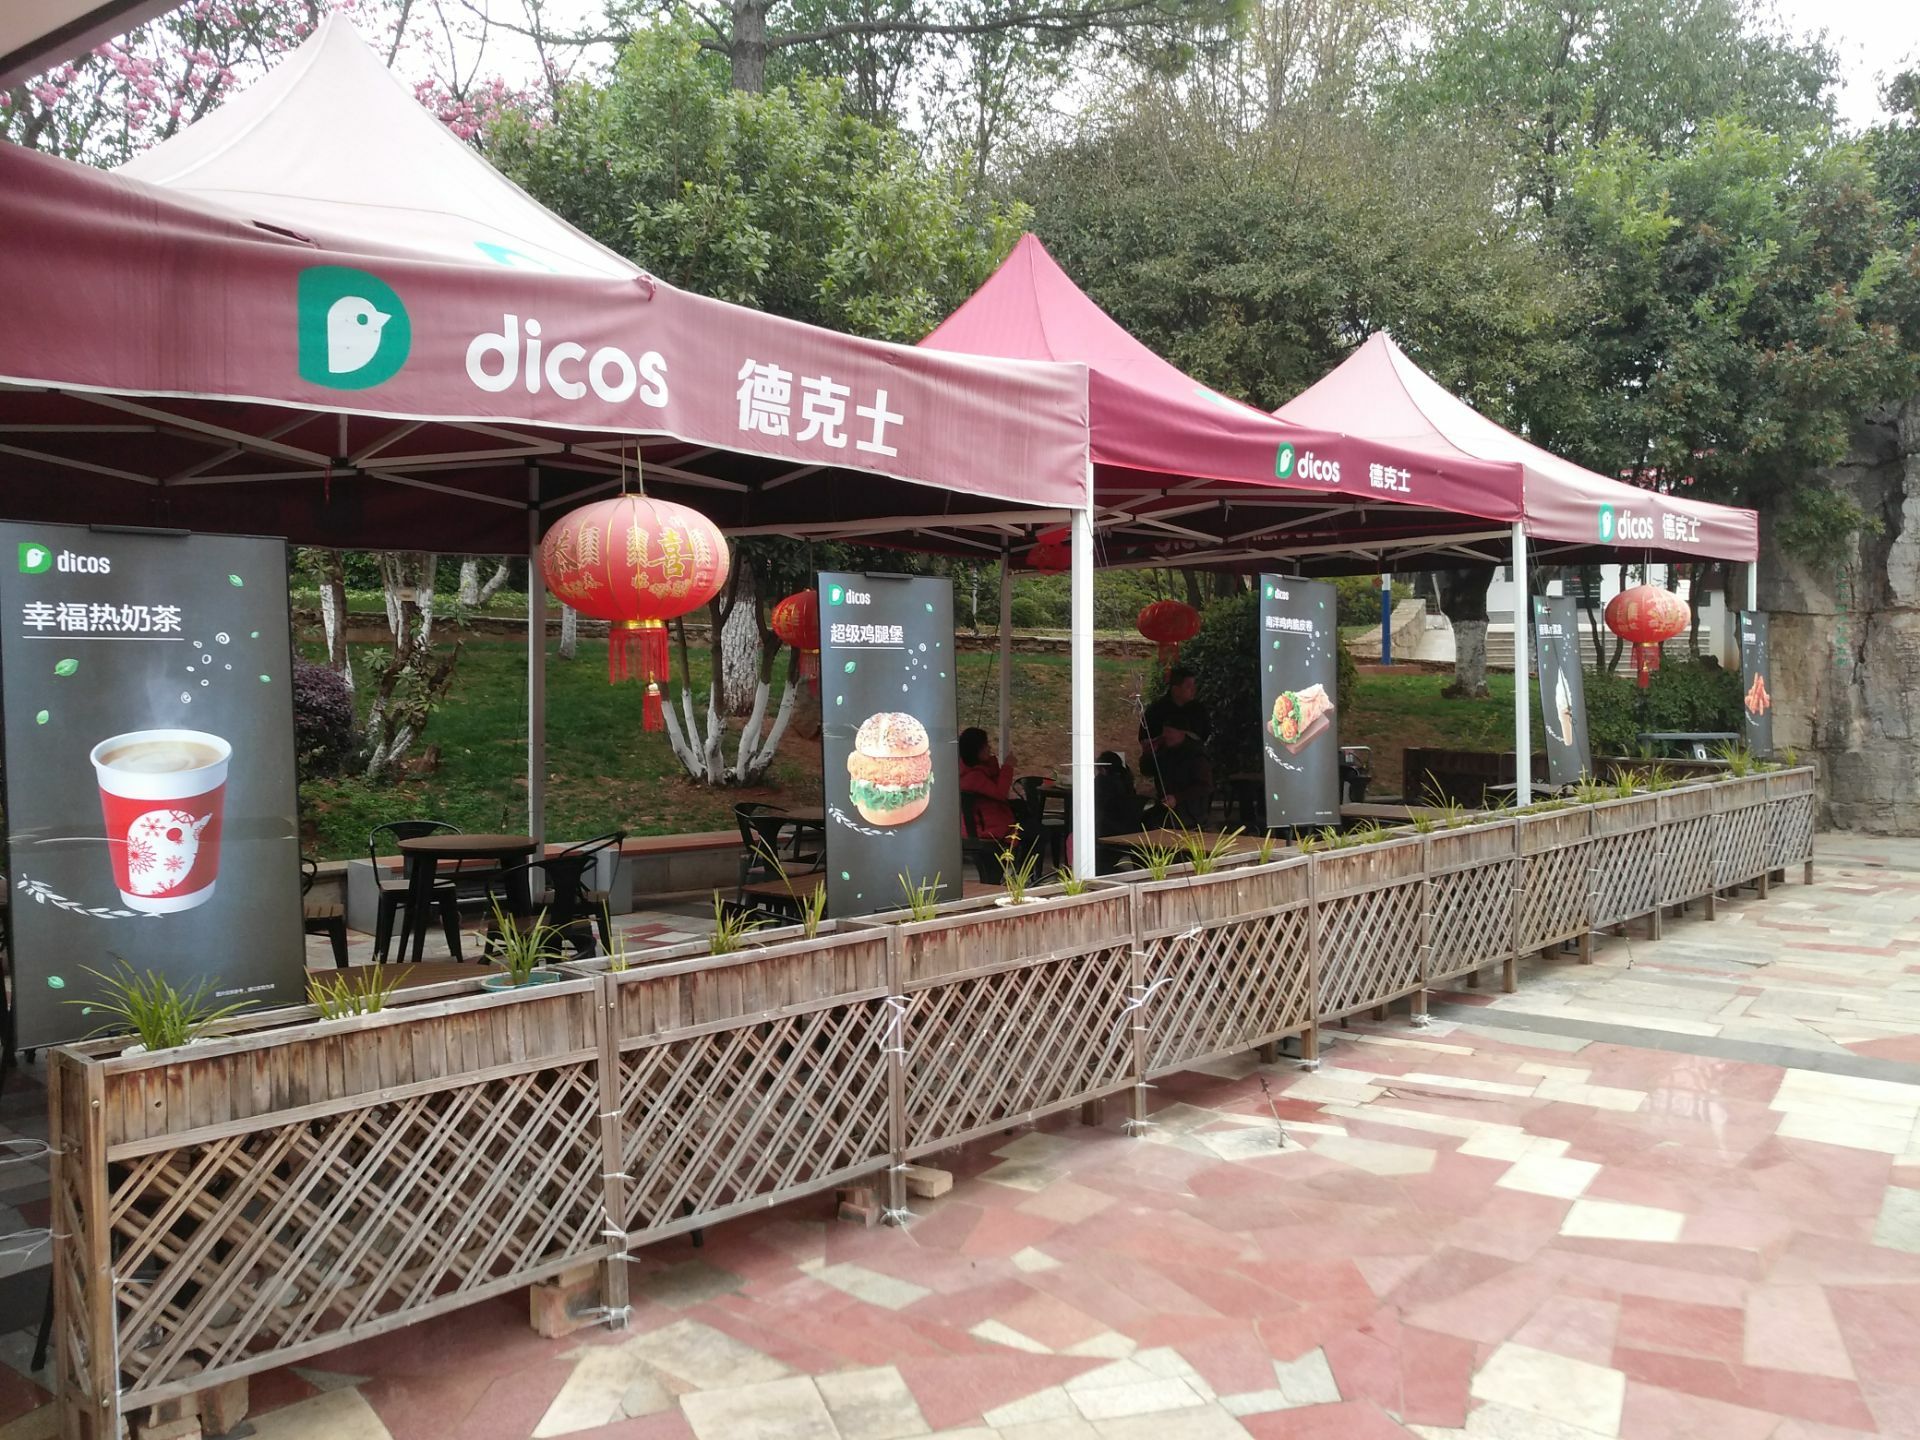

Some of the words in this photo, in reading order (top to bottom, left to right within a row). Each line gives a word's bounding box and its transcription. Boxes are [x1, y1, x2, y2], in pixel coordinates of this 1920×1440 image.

[465, 313, 669, 409] dicos
[735, 358, 904, 459] 德克士
[1297, 451, 1340, 483] dicos
[1369, 463, 1411, 493] 德克士
[1617, 509, 1654, 540] dicos
[1662, 512, 1701, 543] 德克士
[57, 550, 111, 575] dicos
[845, 589, 871, 605] dicos
[22, 601, 182, 633] 幸福热奶茶
[830, 623, 904, 644] 超级鸡腿堡
